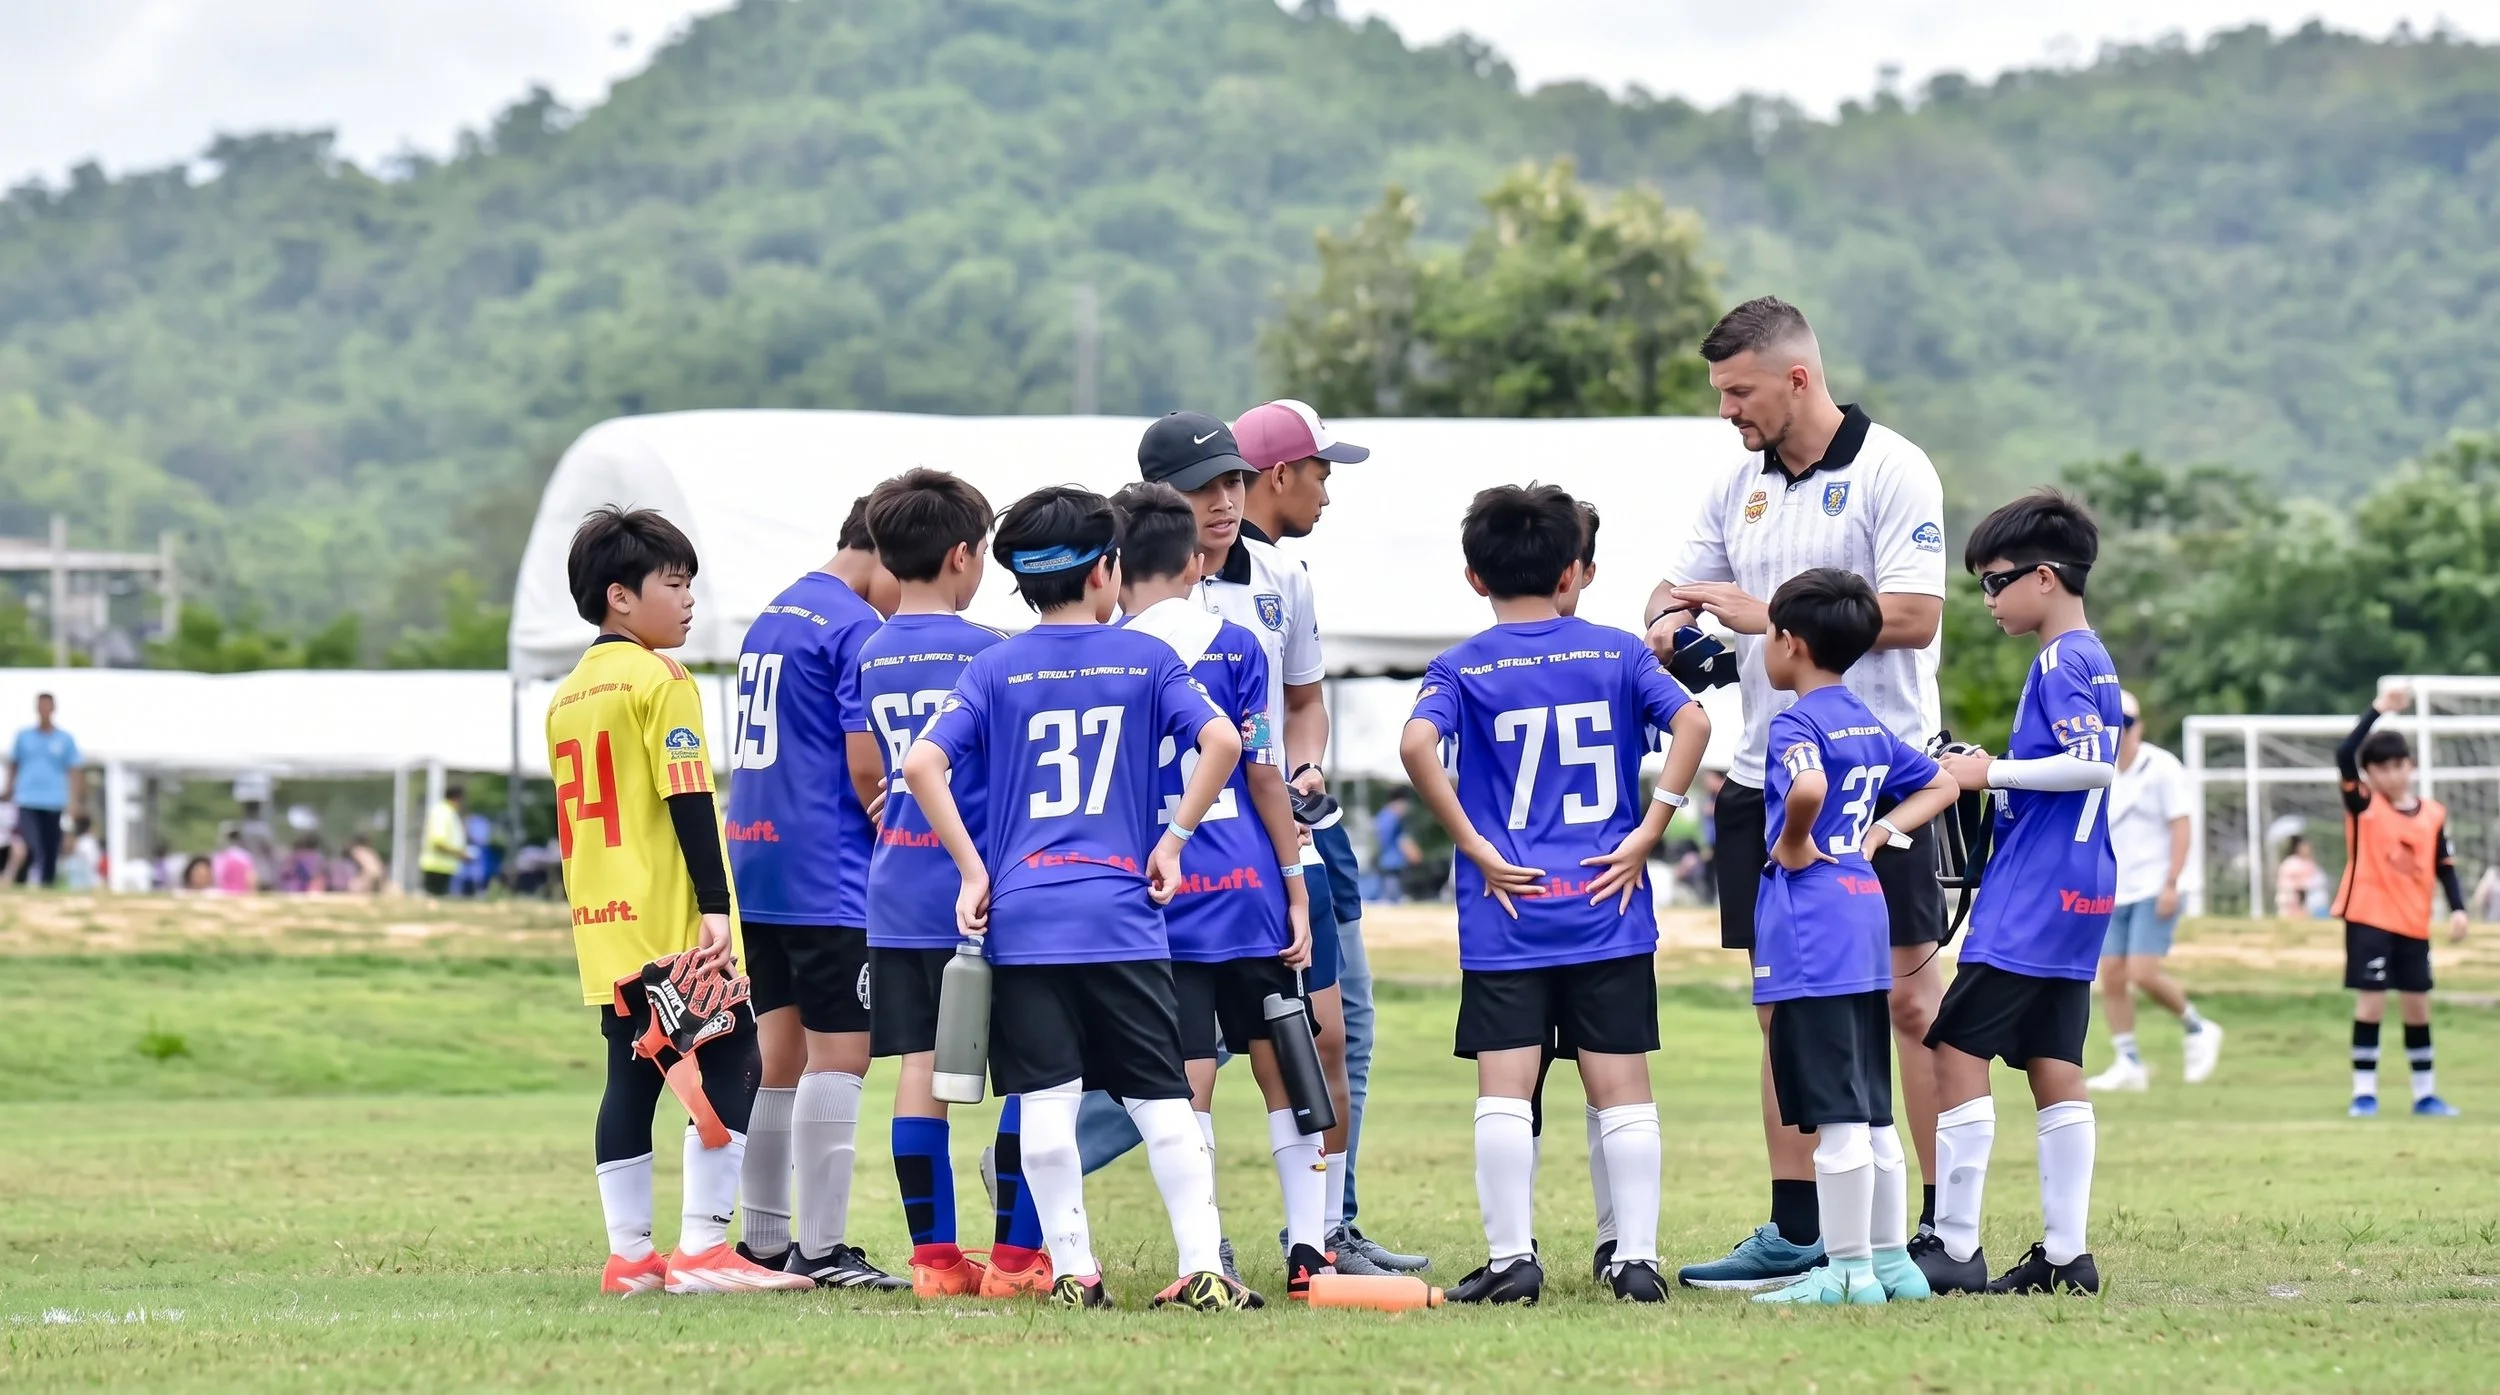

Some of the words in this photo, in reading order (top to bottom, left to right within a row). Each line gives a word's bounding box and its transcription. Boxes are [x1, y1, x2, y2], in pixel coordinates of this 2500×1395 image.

[732, 653, 784, 770] 69
[1028, 705, 1125, 819] 37
[1494, 700, 1618, 830] 75
[556, 731, 622, 860] 24
